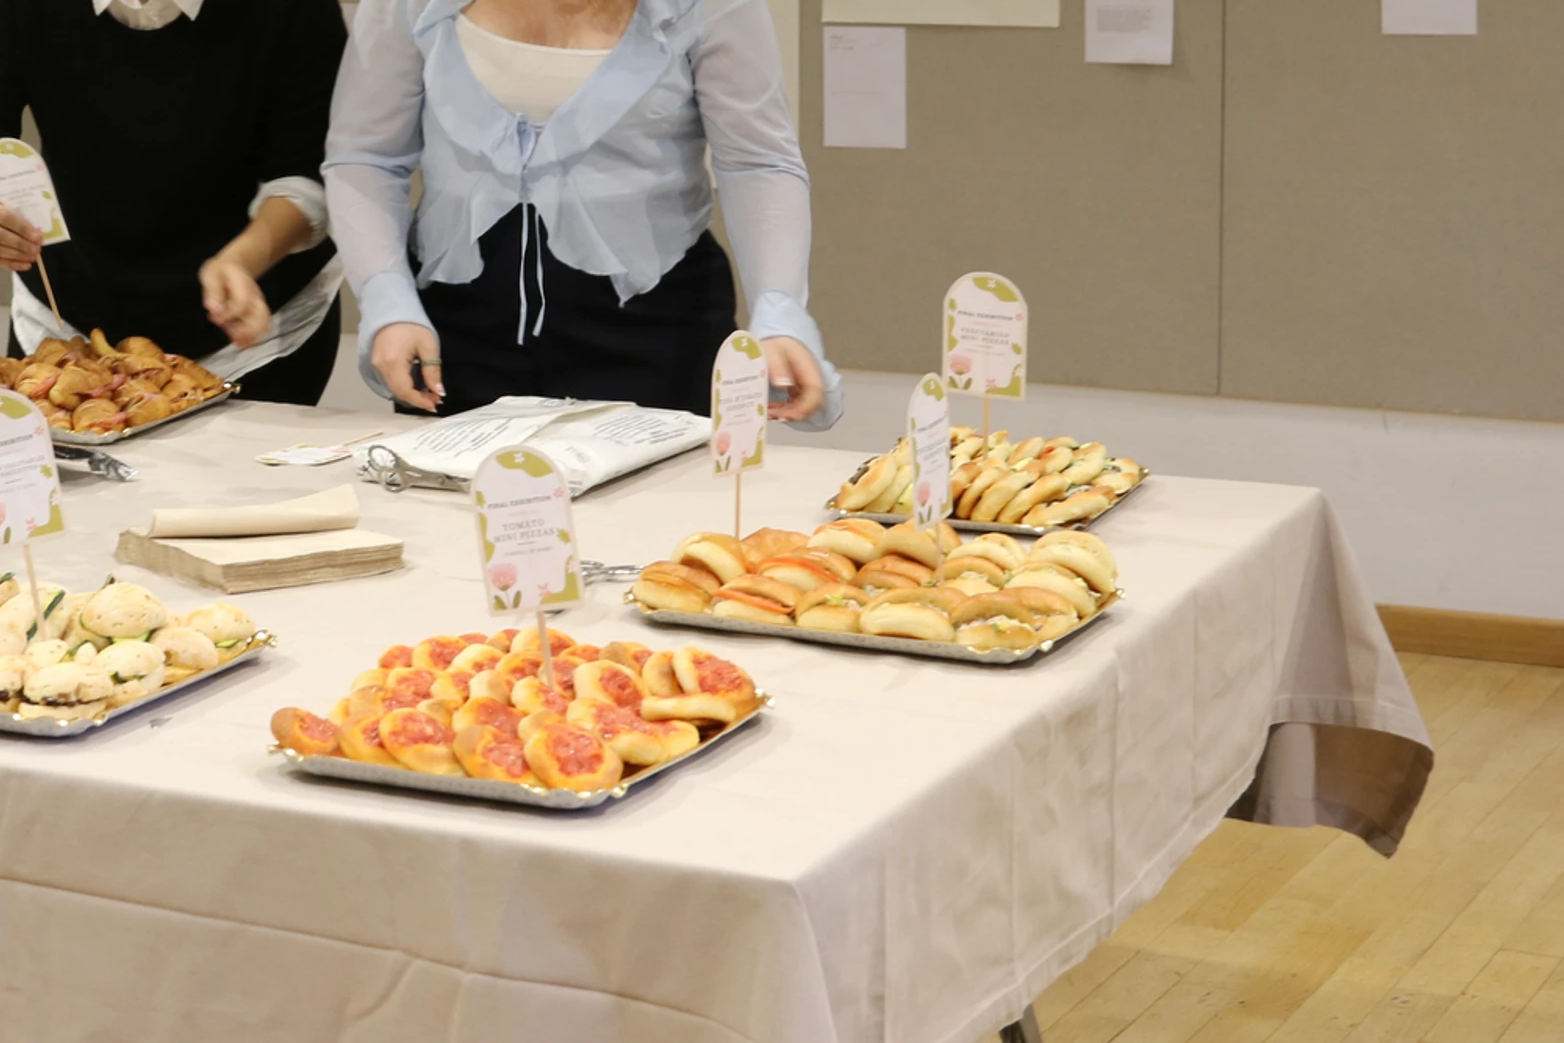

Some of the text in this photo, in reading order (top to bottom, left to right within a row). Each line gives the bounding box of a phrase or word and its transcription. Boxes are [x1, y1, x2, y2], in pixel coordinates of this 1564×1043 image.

[501, 518, 546, 532] TOMATO
[492, 527, 556, 544] MINI PIZZAS
